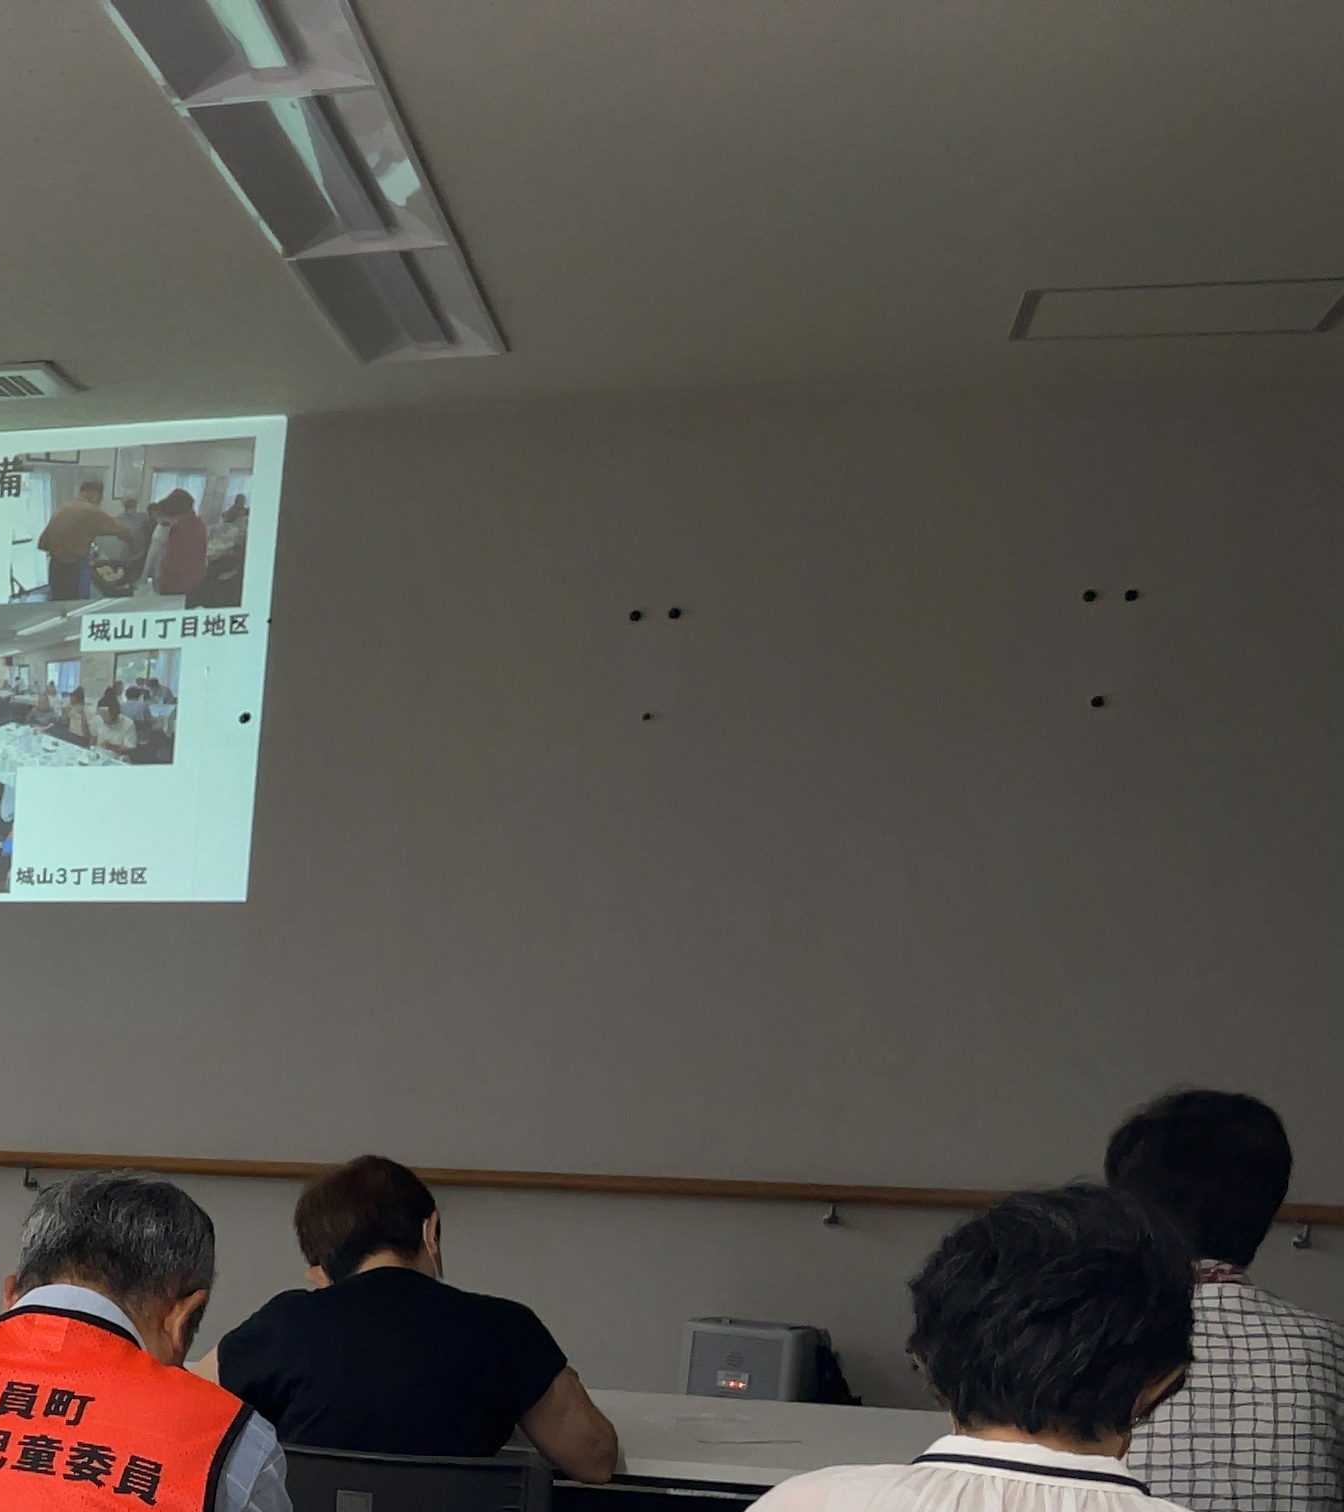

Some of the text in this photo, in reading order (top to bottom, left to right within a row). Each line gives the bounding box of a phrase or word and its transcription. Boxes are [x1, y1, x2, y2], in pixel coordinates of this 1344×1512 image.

[88, 613, 250, 641] 城山1丁目地区
[15, 866, 148, 885] 城山3丁目地区
